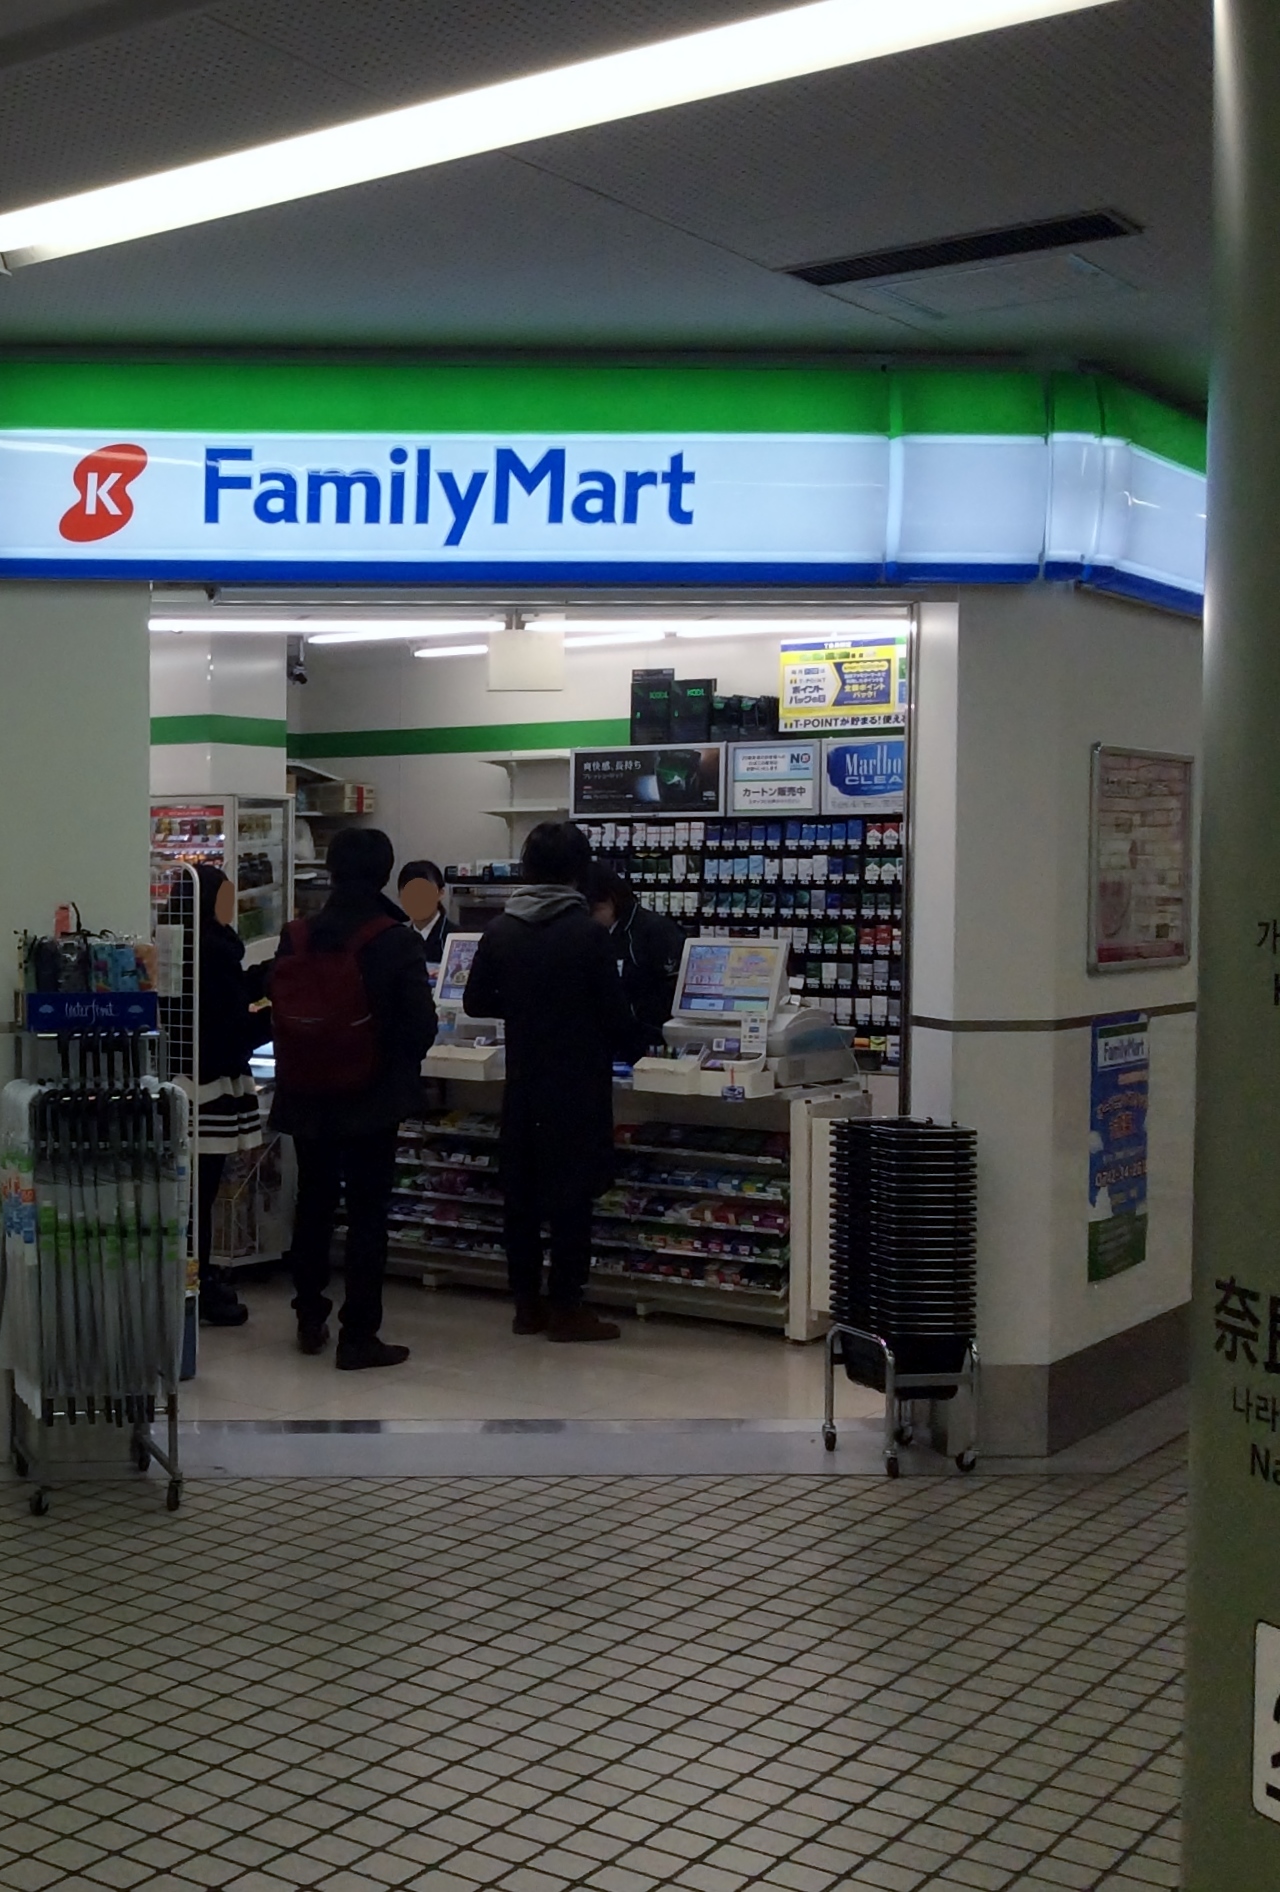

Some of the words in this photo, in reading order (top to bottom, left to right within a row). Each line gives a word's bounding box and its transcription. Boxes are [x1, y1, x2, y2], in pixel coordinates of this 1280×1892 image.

[204, 445, 695, 546] FamilyMart
[742, 786, 806, 797] カートン販売中
